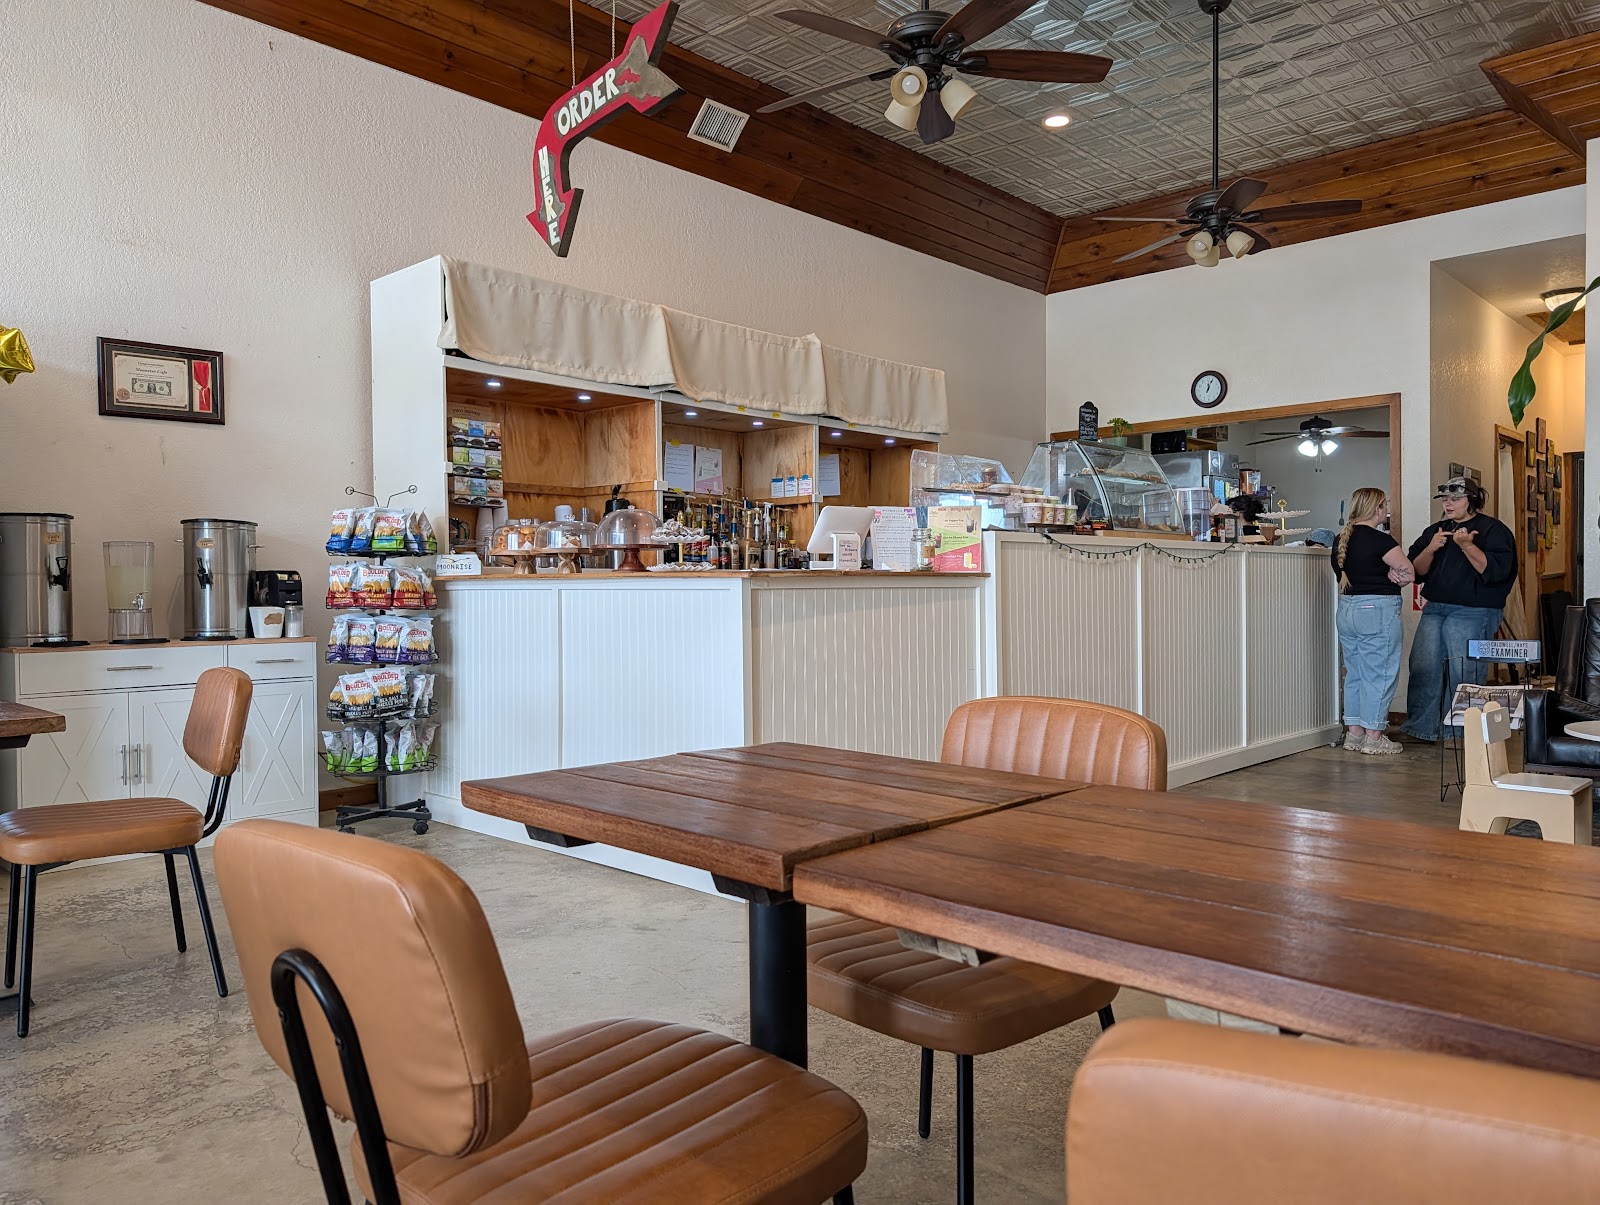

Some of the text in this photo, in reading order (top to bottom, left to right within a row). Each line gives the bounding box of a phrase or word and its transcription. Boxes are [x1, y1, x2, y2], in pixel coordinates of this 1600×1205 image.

[557, 67, 620, 136] ORDER
[538, 145, 561, 246] HERE
[362, 568, 389, 577] BOULDER
[1491, 648, 1528, 657] EXAMINER
[373, 672, 400, 683] BOULDER
[345, 682, 371, 691] BOULDER
